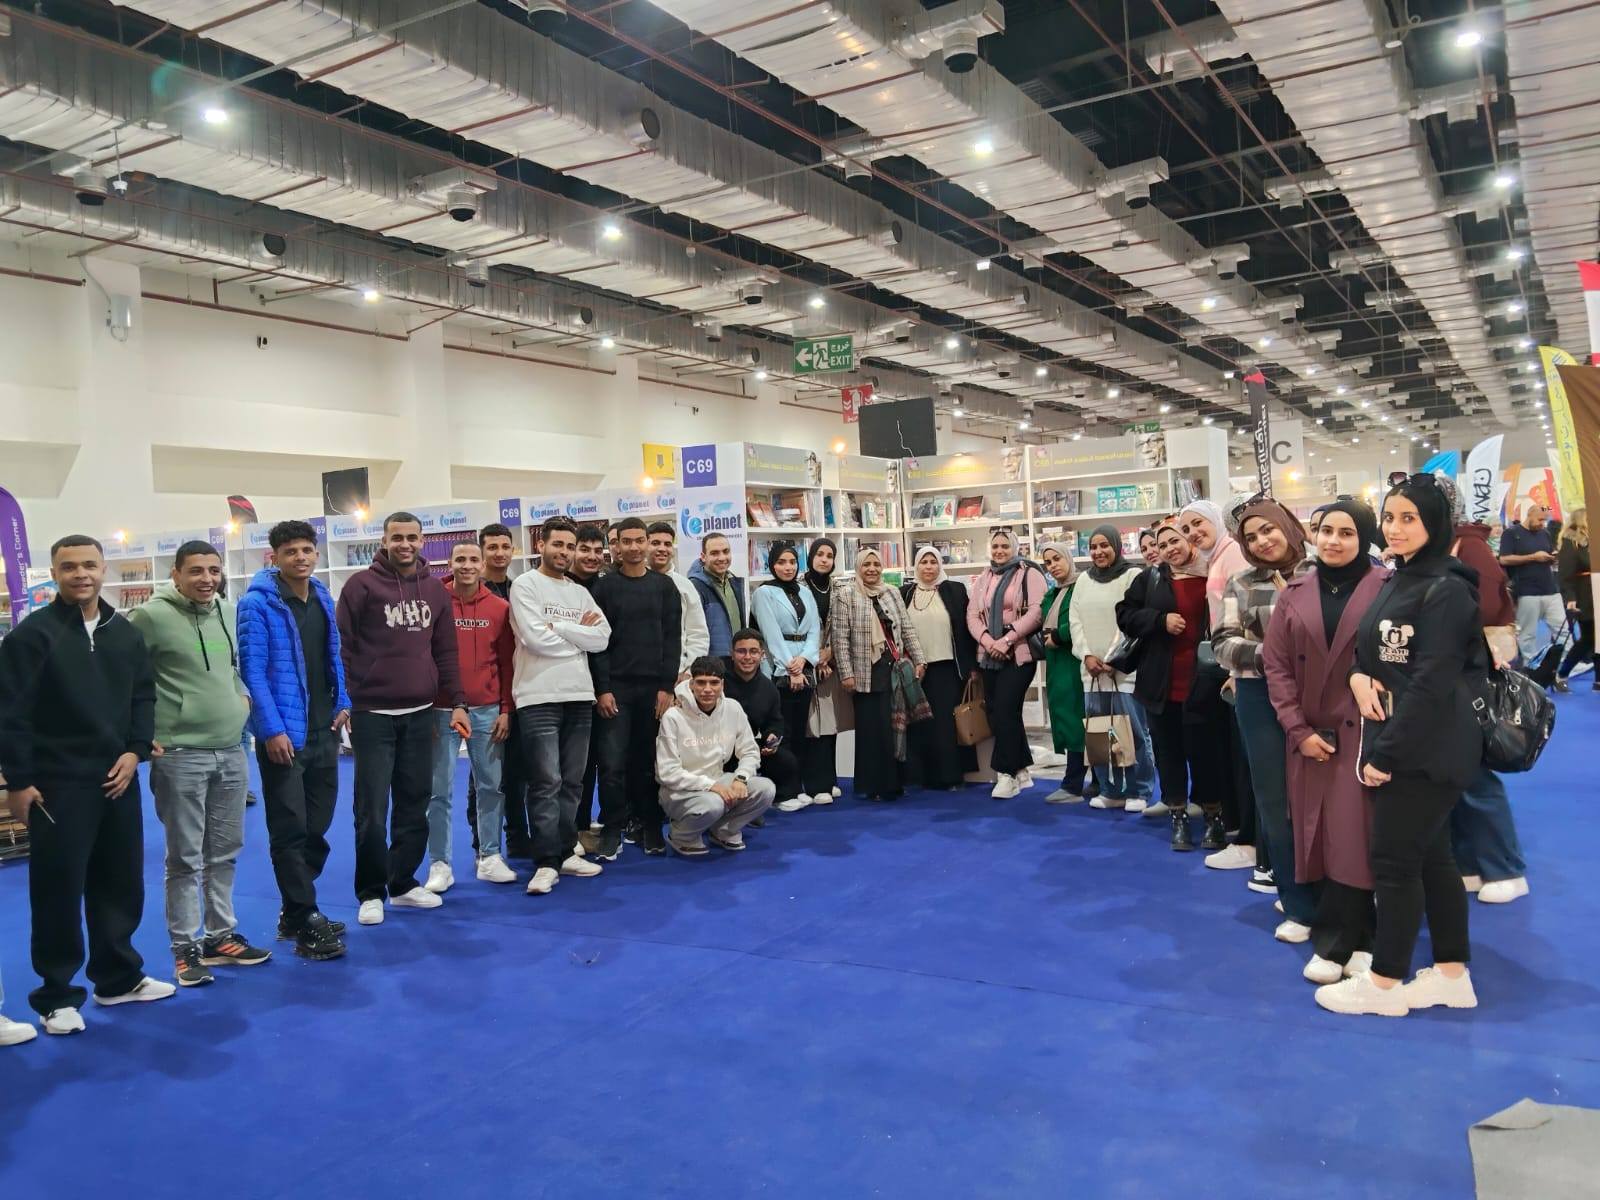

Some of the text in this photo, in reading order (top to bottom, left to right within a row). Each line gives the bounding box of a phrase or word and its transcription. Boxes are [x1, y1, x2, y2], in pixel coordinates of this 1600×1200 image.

[830, 341, 850, 353] خروج
[830, 355, 851, 367] EXIT
[1271, 440, 1293, 465] C
[686, 458, 714, 475] C69
[501, 507, 520, 519] C69
[11, 516, 22, 550] Corner
[316, 526, 326, 535] 69
[384, 599, 432, 628] WHO
